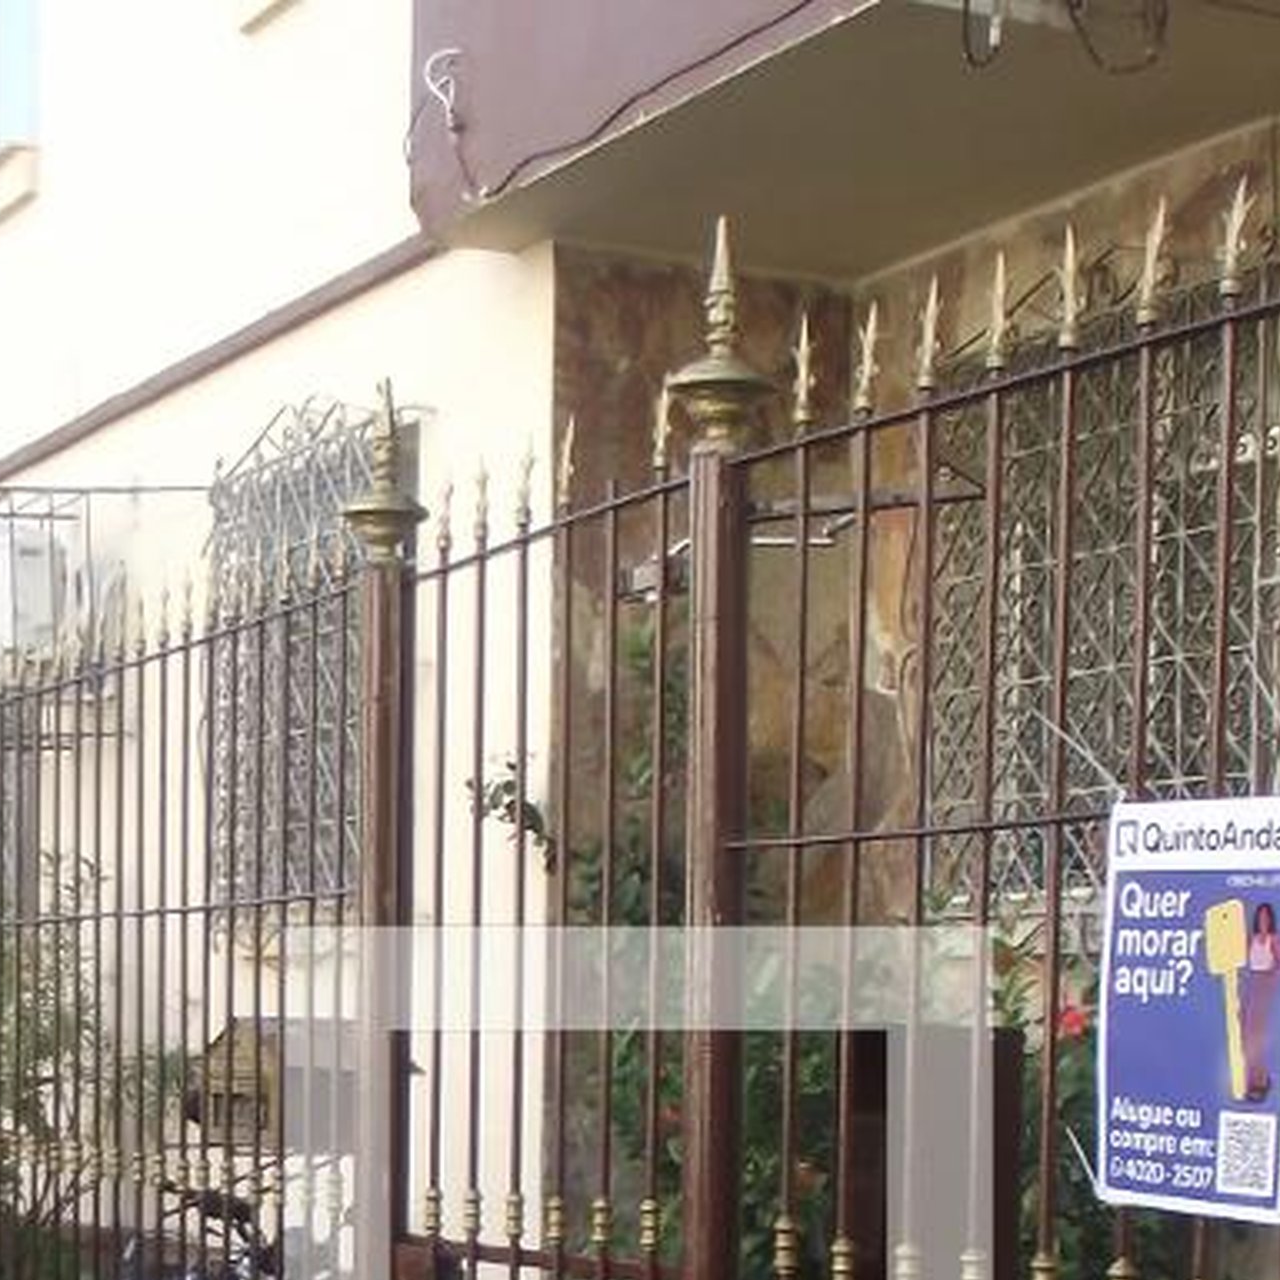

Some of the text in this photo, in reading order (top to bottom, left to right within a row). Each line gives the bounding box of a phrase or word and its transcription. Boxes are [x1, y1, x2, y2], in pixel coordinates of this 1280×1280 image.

[1121, 882, 1190, 918] Quer
[1118, 928, 1202, 958] morar
[1115, 958, 1193, 1003] aqui?
[1110, 1096, 1202, 1130] Alugue ou
[1109, 1130, 1177, 1157] compre
